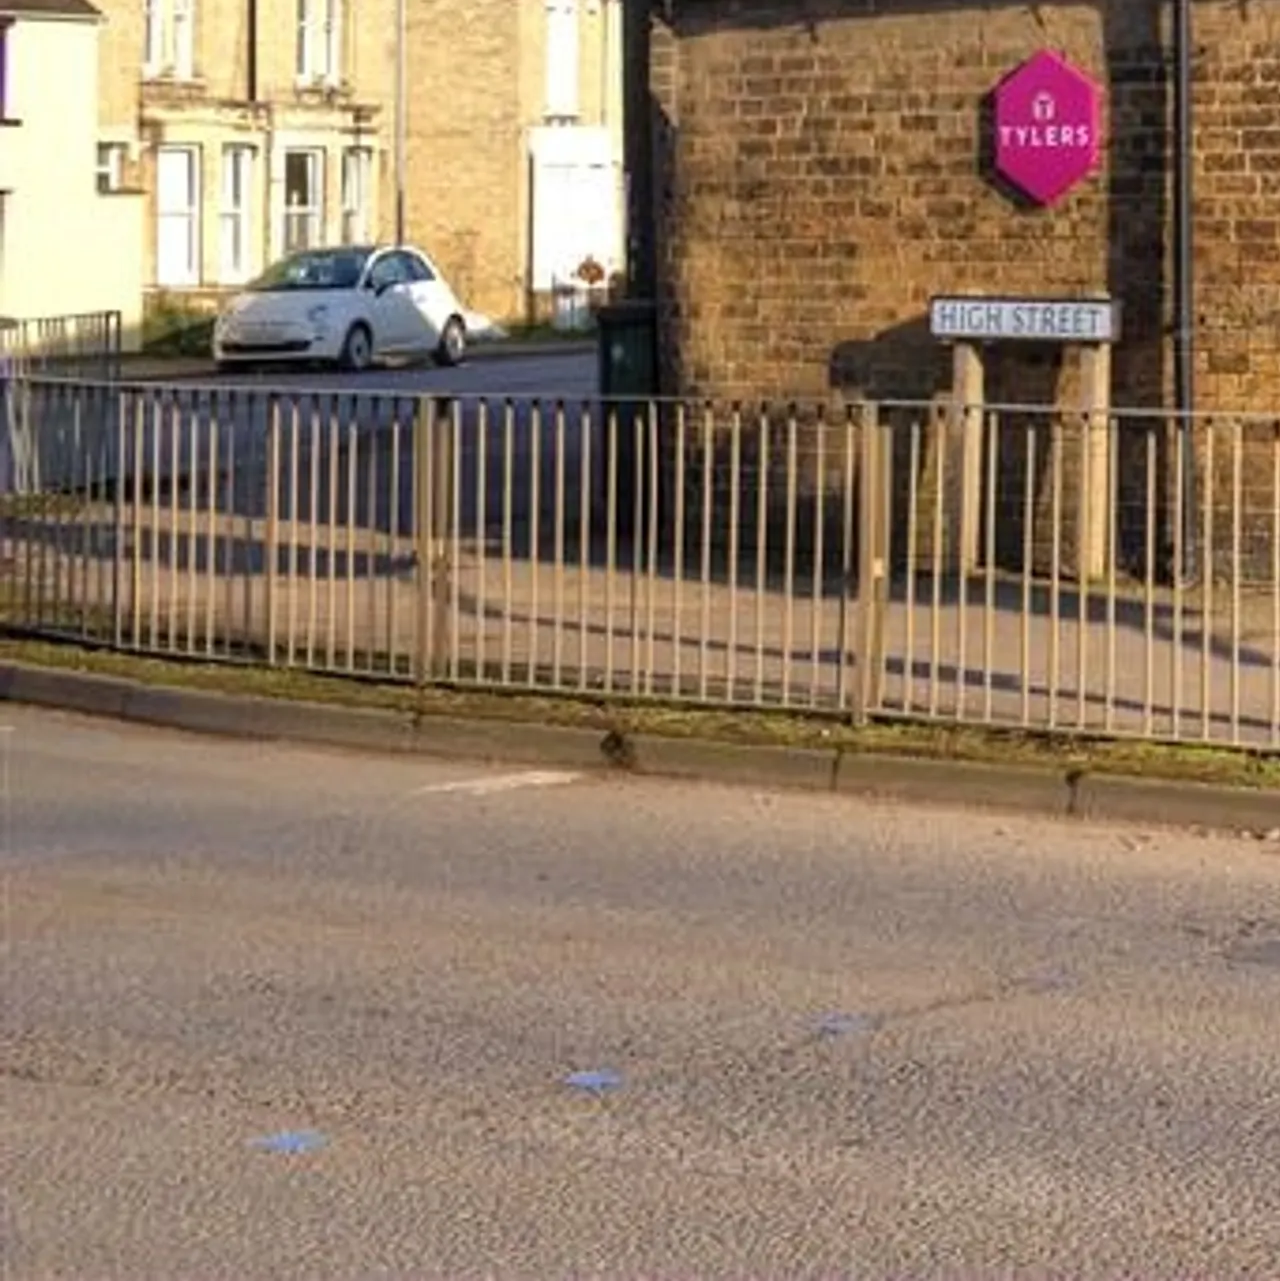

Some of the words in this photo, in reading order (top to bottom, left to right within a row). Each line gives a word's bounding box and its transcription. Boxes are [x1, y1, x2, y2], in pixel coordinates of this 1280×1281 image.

[999, 125, 1089, 147] TYLERS
[939, 305, 1003, 331] HIGH
[1012, 305, 1101, 334] STREET
